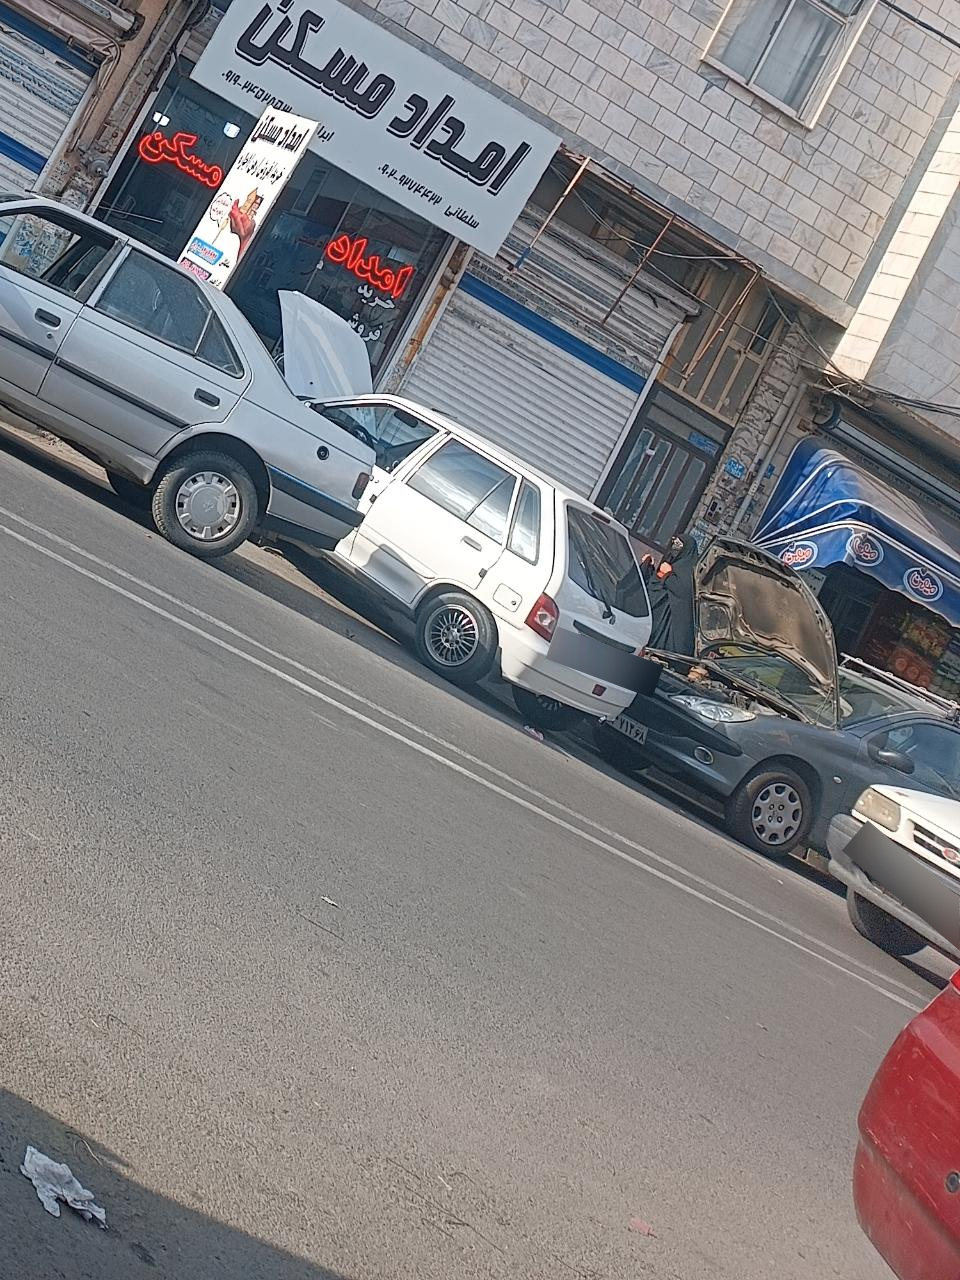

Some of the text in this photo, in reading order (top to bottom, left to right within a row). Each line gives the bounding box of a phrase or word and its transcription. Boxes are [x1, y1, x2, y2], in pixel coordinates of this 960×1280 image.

[251, 114, 310, 153] امداد مسکن
[386, 94, 532, 196] امداد
[139, 131, 224, 188] مسکن
[443, 205, 480, 229] سلطانی
[326, 234, 414, 299] امداد
[358, 284, 396, 310] خرید
